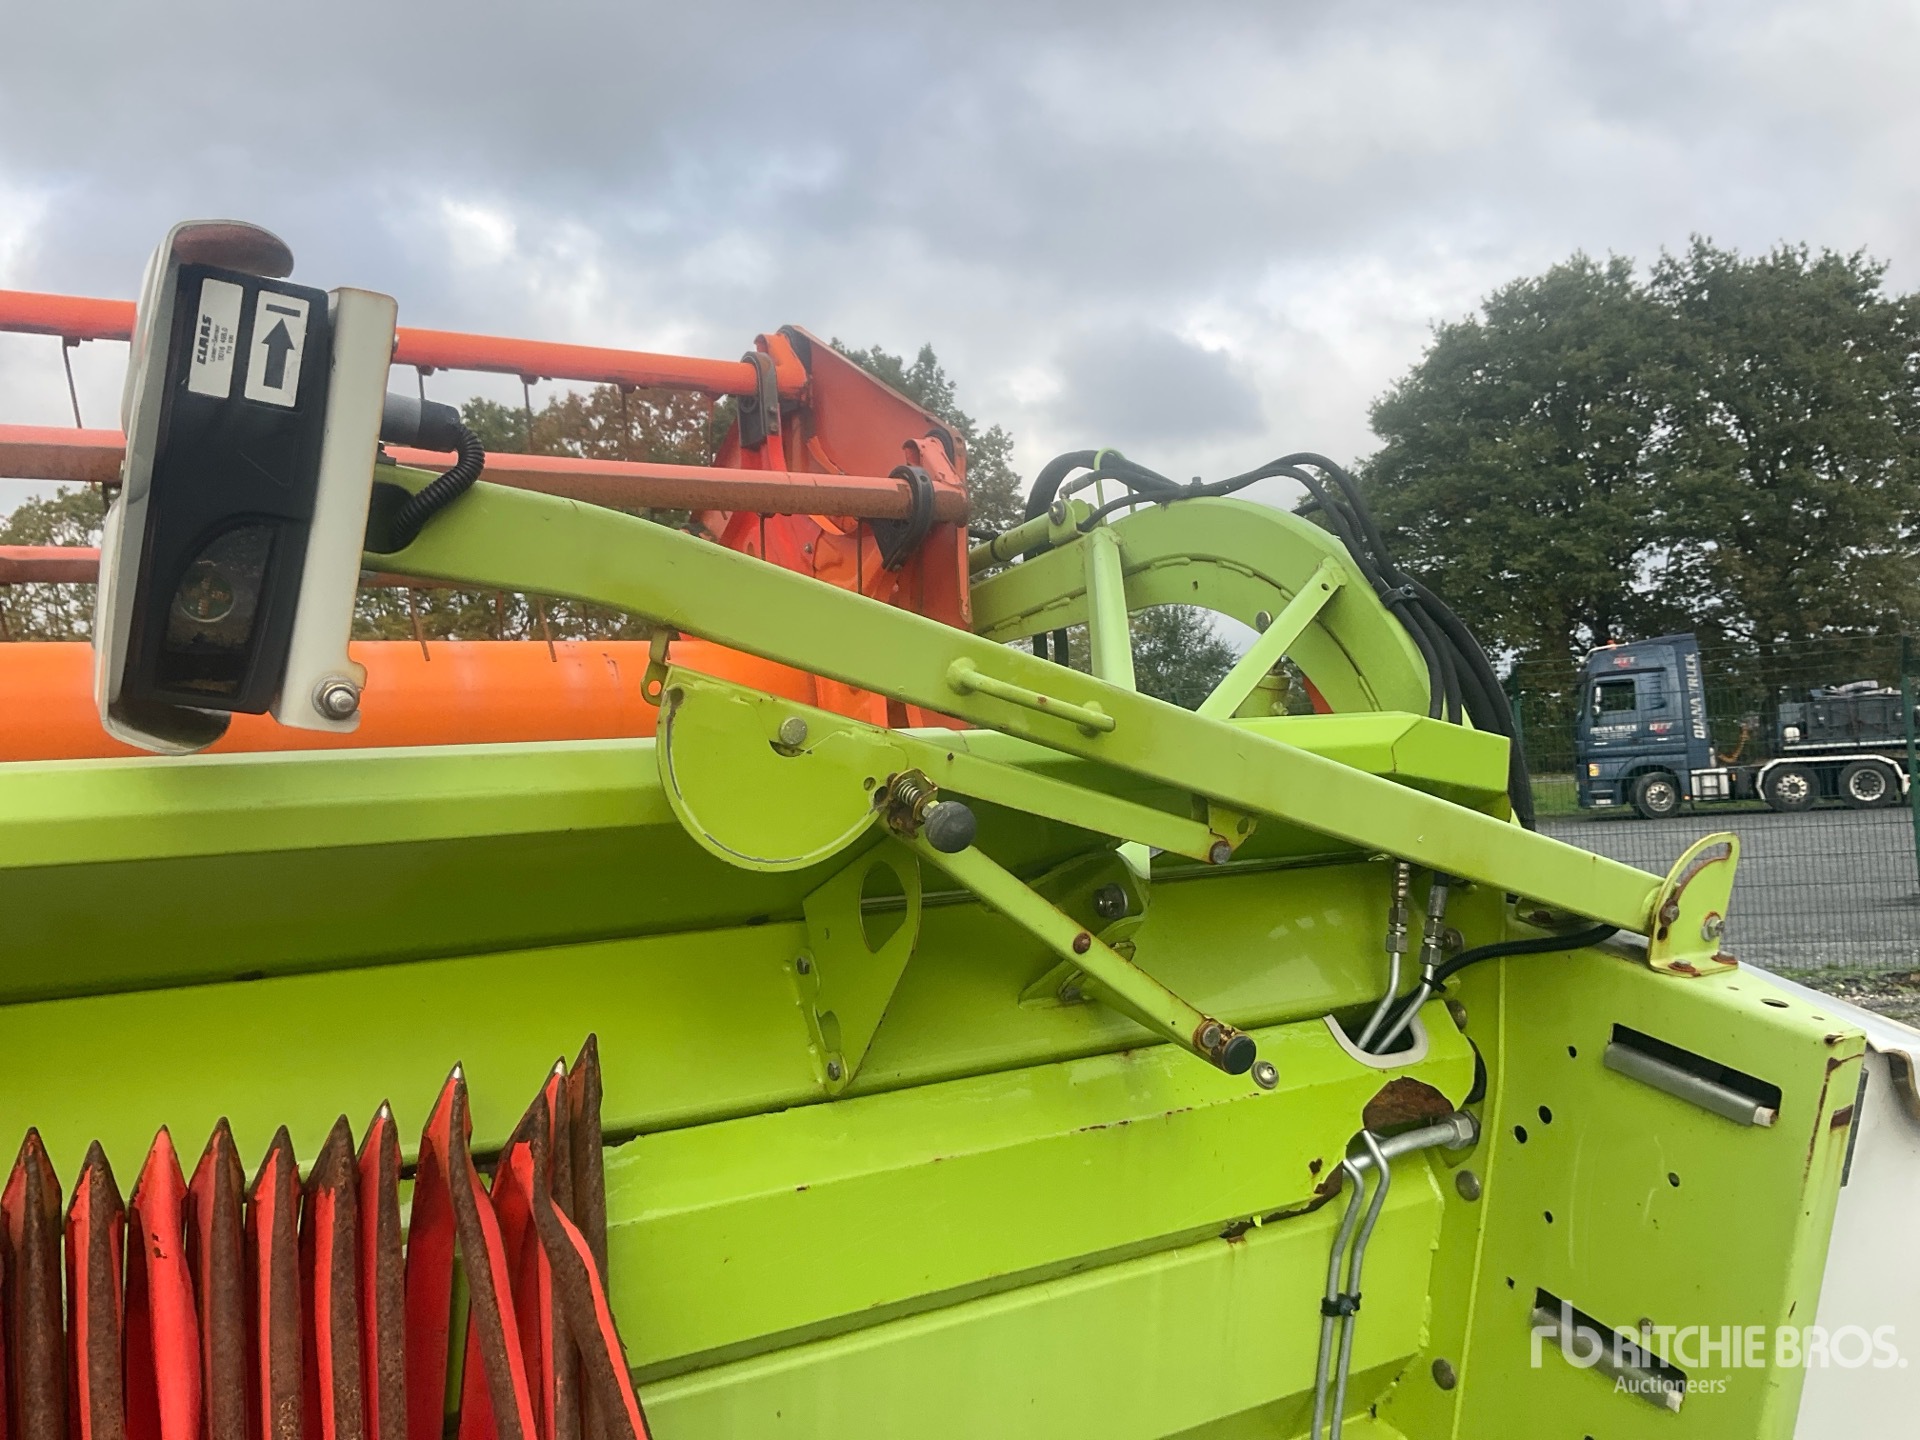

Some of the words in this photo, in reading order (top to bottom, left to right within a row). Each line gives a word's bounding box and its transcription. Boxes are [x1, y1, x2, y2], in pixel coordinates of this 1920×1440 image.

[196, 314, 212, 365] CLAAS
[1684, 653, 1701, 695] TRUCK
[1689, 697, 1706, 739] DIANA
